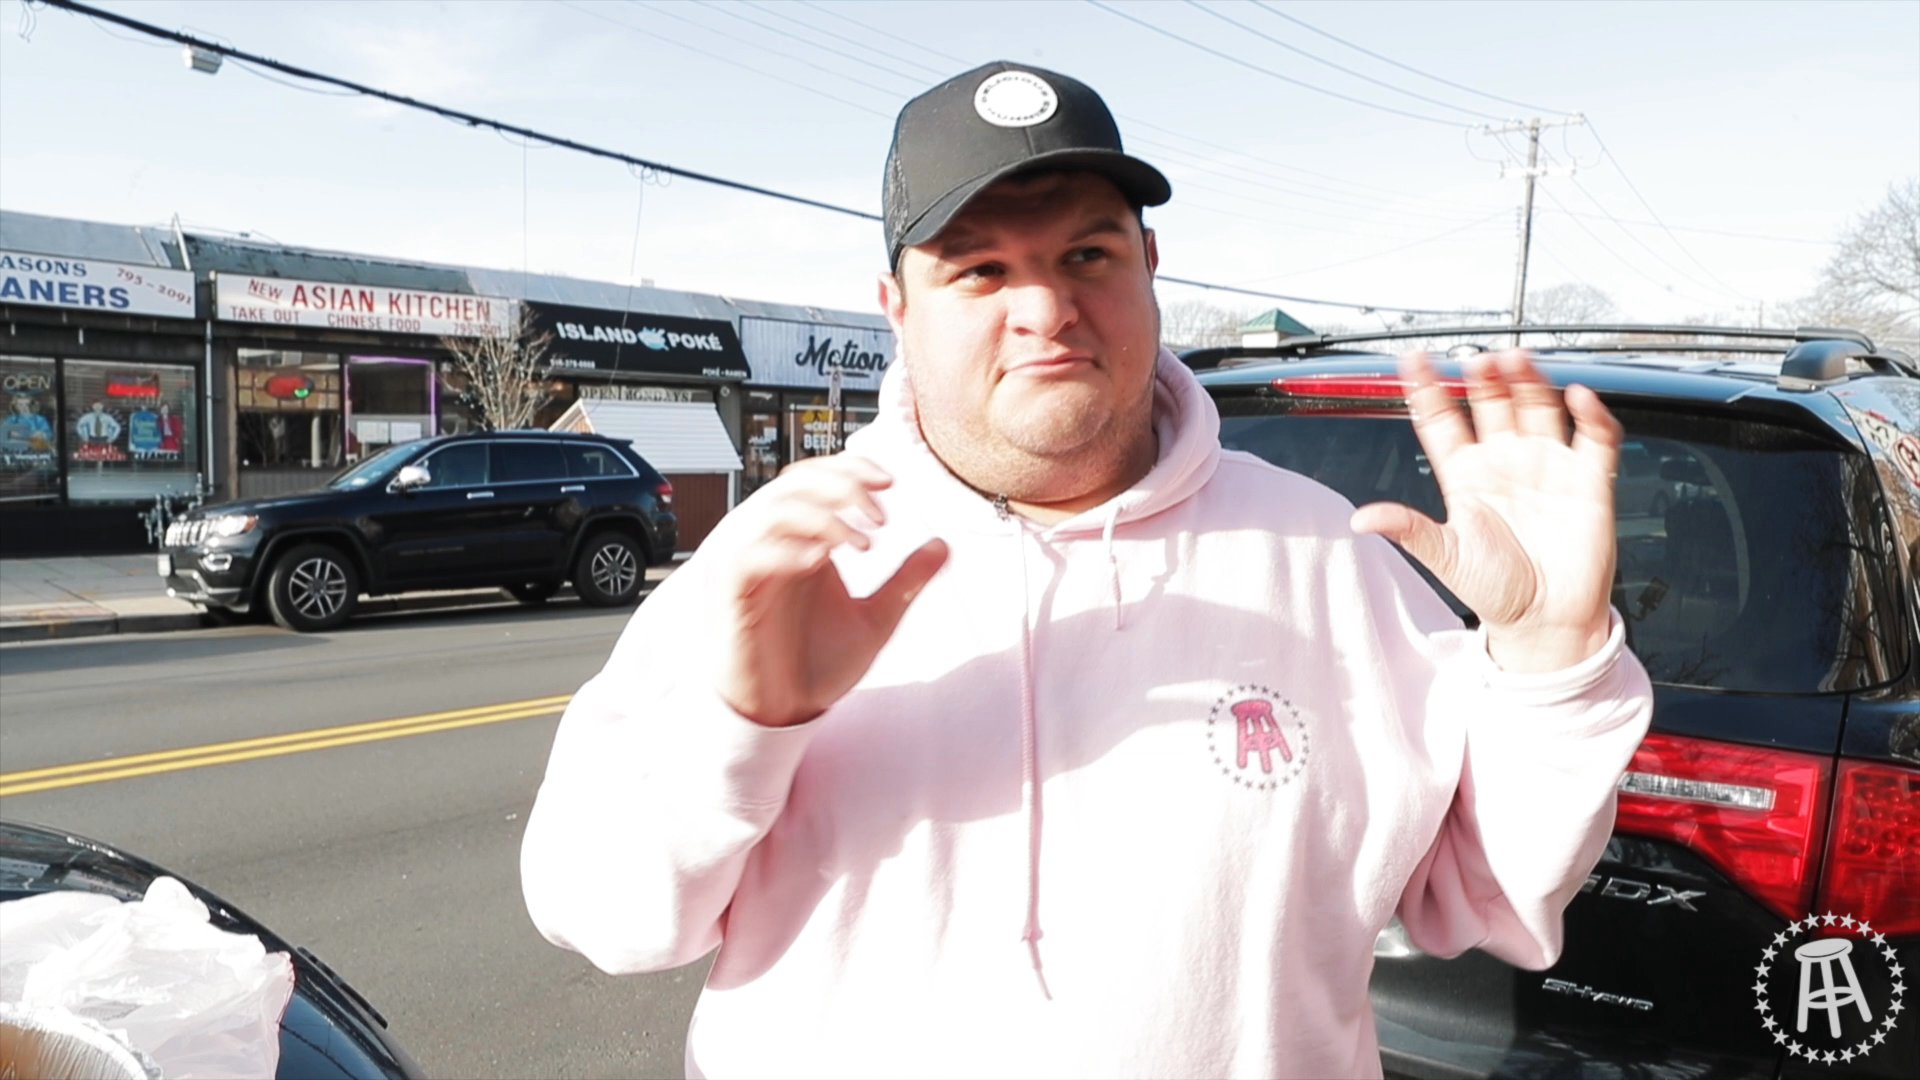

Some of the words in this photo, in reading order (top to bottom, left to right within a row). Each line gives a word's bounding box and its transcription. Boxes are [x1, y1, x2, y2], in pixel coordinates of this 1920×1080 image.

[0, 255, 87, 277] ASONS
[1, 277, 130, 309] ANERS
[249, 279, 282, 300] NEW
[292, 284, 374, 313] ASIAN
[388, 292, 491, 322] KITCHEN
[231, 306, 266, 321] TAKE
[274, 309, 300, 324] OUT
[327, 313, 381, 330] CHINESE
[389, 318, 421, 333] FOOD
[556, 321, 638, 345] ISLAND
[666, 332, 723, 351] POKÉ
[796, 334, 888, 377] Motion
[4, 376, 50, 390] OPEN
